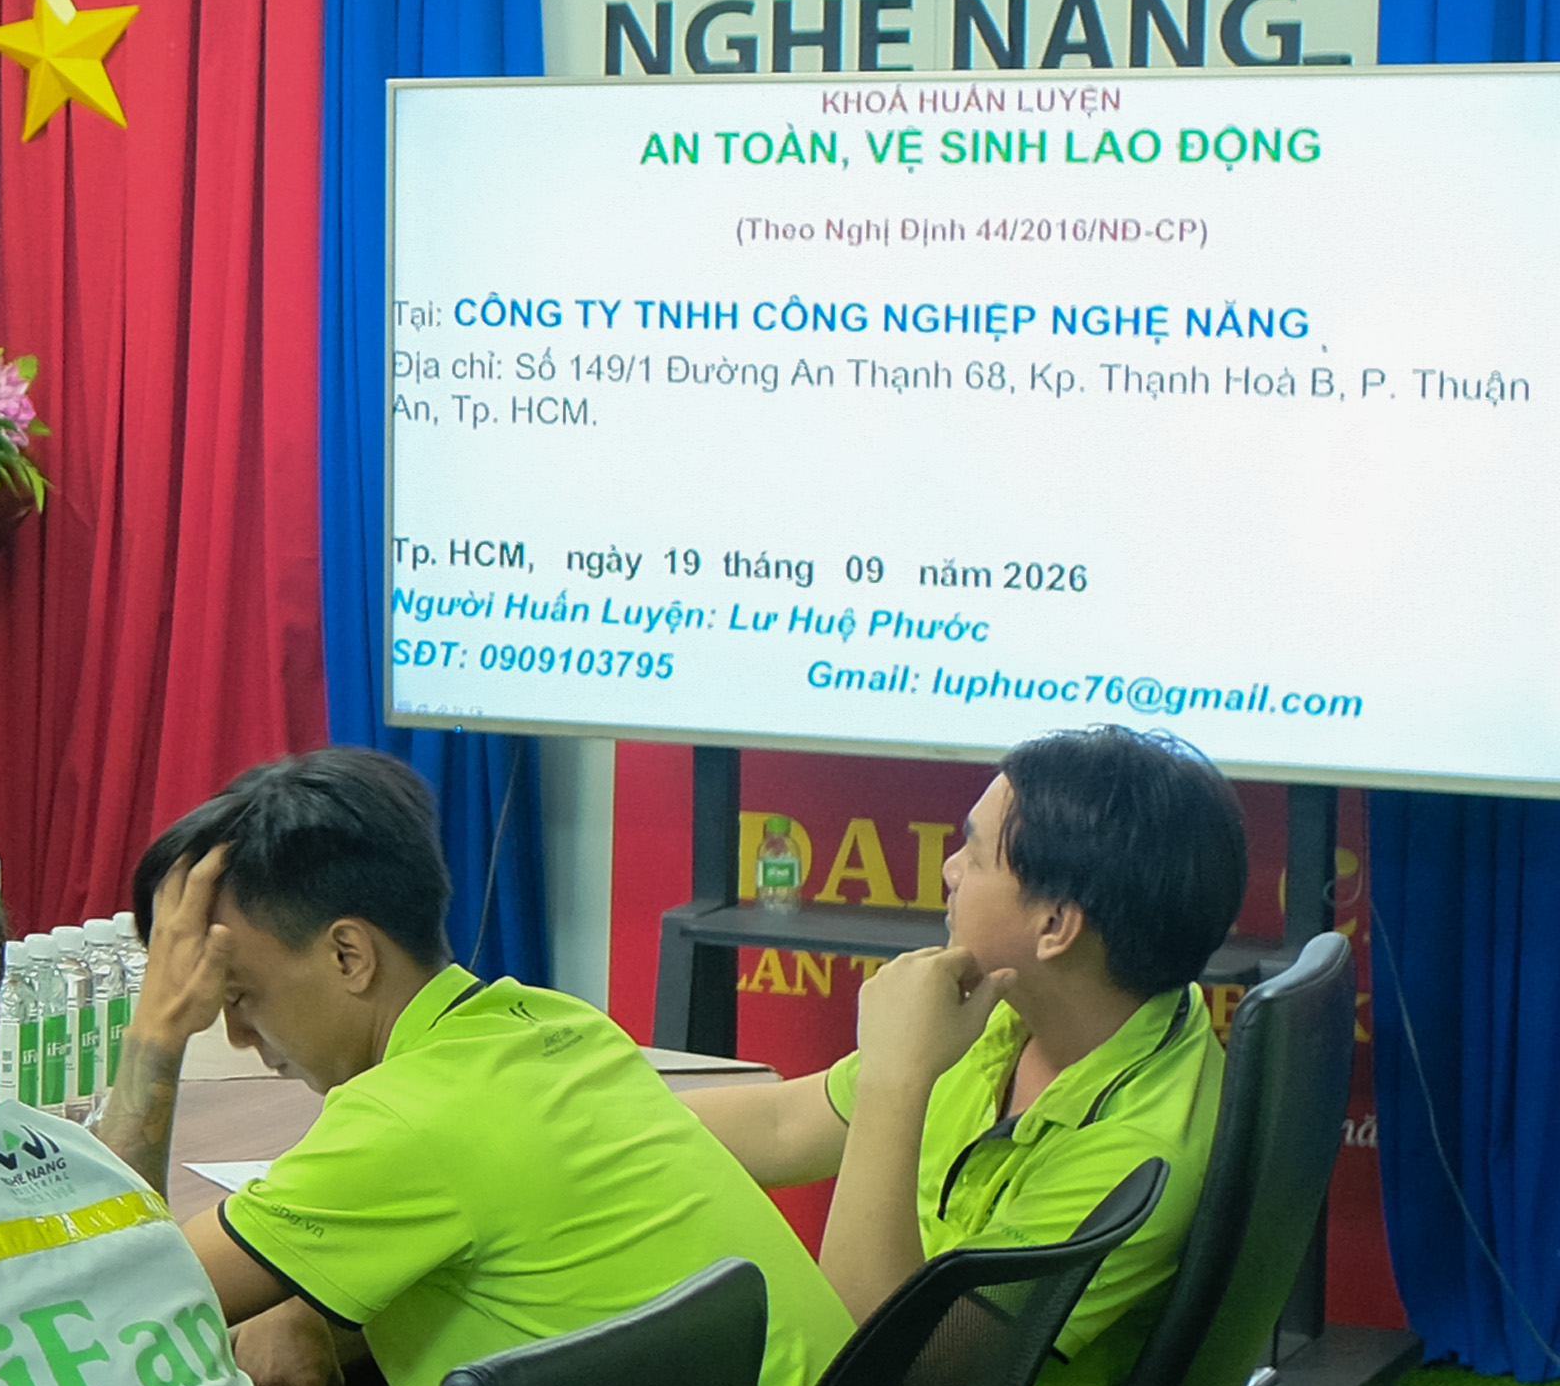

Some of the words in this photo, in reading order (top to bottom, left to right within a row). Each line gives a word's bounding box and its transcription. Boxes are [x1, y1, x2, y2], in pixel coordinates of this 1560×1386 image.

[821, 84, 909, 114] KHOÁ
[1017, 86, 1121, 119] LUYỆN
[639, 130, 699, 165] AN
[714, 122, 850, 171] TOÀN,
[865, 124, 924, 175] VỆ
[939, 128, 1048, 165] SINH
[1064, 127, 1163, 164] LAO
[1177, 123, 1321, 172] ĐỘNG
[735, 216, 817, 247] (Theo
[824, 217, 890, 247] Nghị
[900, 217, 967, 247] Định
[392, 299, 442, 332] Tại:
[453, 291, 564, 328] CÔNG
[575, 299, 623, 328] TY
[634, 299, 739, 330] TNHH
[751, 294, 870, 333] CÔNG
[883, 303, 1037, 342] NGHIỆP
[1050, 305, 1170, 345] NGHỆ
[1185, 299, 1311, 340] NĂNG
[451, 351, 504, 381] chỉ:
[514, 346, 557, 383] Số
[569, 354, 654, 385] 149/1
[666, 354, 780, 393] Đường
[789, 359, 835, 388] An
[846, 357, 953, 395] Thạnh
[964, 361, 1017, 396] 68,
[1028, 362, 1086, 398] Kp.
[1098, 362, 1211, 401] Thạnh
[1310, 366, 1346, 402] B,
[1361, 367, 1397, 401] P.
[1412, 367, 1531, 408] Thuận
[392, 395, 440, 427] An,
[451, 394, 500, 430] Tp.
[511, 397, 599, 428] HCM.
[392, 536, 437, 572] Tp.
[448, 537, 535, 574] HCM,
[566, 544, 643, 581] ngày
[663, 547, 702, 577] 19
[723, 550, 815, 589] tháng
[845, 554, 886, 584] 09
[918, 557, 993, 589] năm
[1002, 561, 1089, 594] 2026
[392, 586, 495, 624] Người
[504, 587, 591, 624] Huấn
[601, 596, 717, 635] Luyện:
[728, 602, 779, 632] Lư
[787, 604, 857, 644] Huệ
[868, 609, 992, 644] Phước
[392, 637, 468, 670] SĐT:
[479, 642, 676, 681] 0909103795
[806, 659, 920, 694] Gmail:
[930, 666, 1364, 720] luphuoc76@gmail.com
